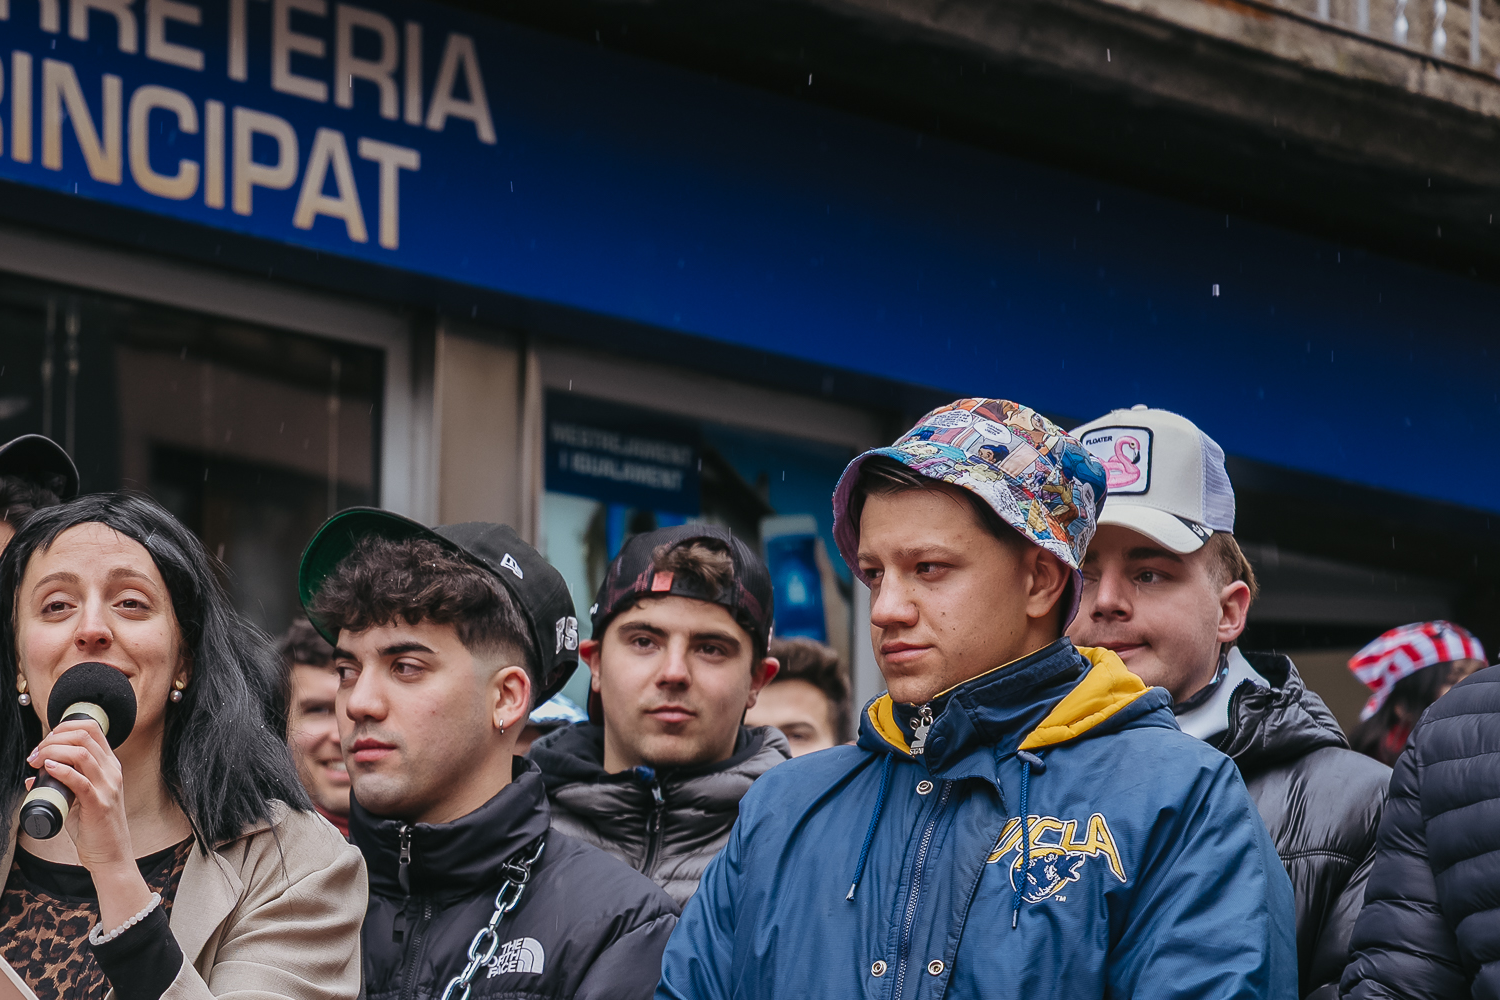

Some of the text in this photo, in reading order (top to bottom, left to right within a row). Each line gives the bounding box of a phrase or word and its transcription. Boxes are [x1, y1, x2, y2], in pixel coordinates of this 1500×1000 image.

[1085, 435, 1113, 446] FLOATER
[987, 813, 1127, 883] UCLA
[501, 937, 524, 954] THE
[482, 950, 520, 967] ORTH
[487, 961, 518, 979] FACE
